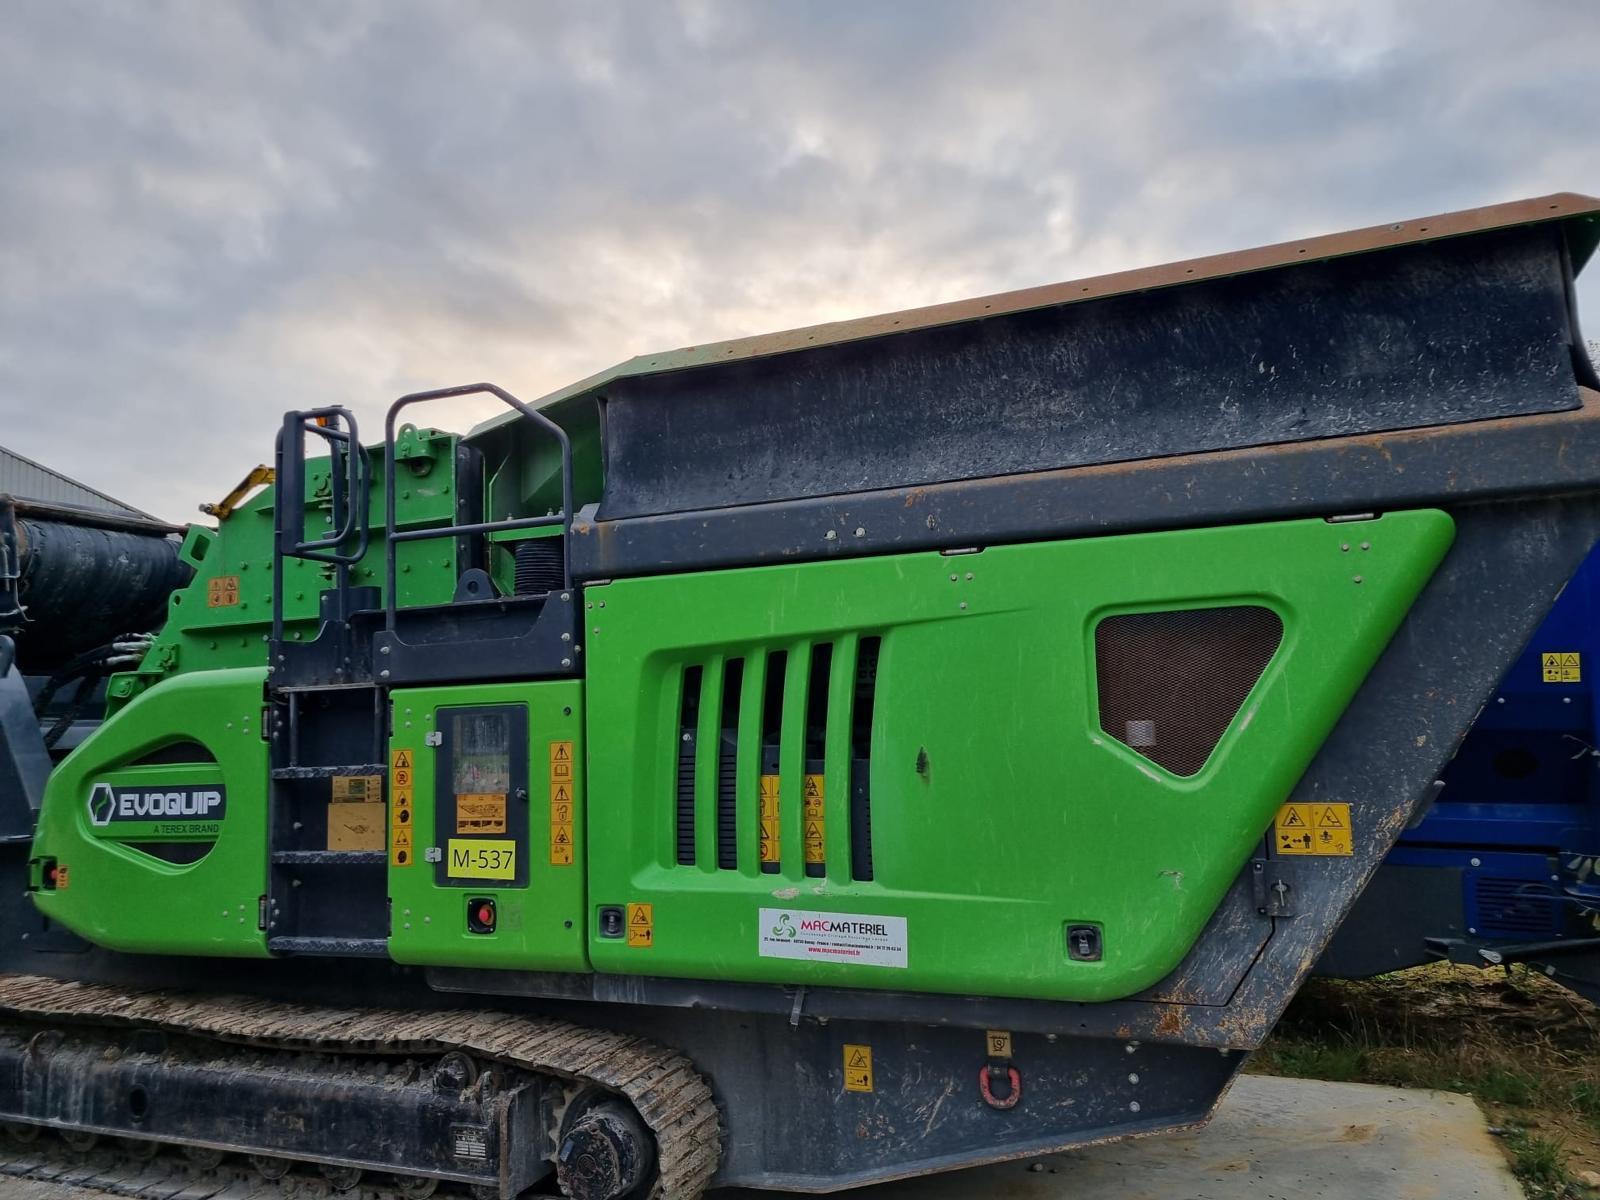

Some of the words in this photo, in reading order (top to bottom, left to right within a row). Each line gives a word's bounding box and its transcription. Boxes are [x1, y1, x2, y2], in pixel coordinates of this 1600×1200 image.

[120, 791, 221, 816] EVOQUIP
[153, 825, 160, 833] A
[161, 824, 187, 833] TEREX
[189, 824, 219, 833] BRAND
[453, 849, 513, 869] M-537
[801, 920, 888, 936] MACMATERIEL
